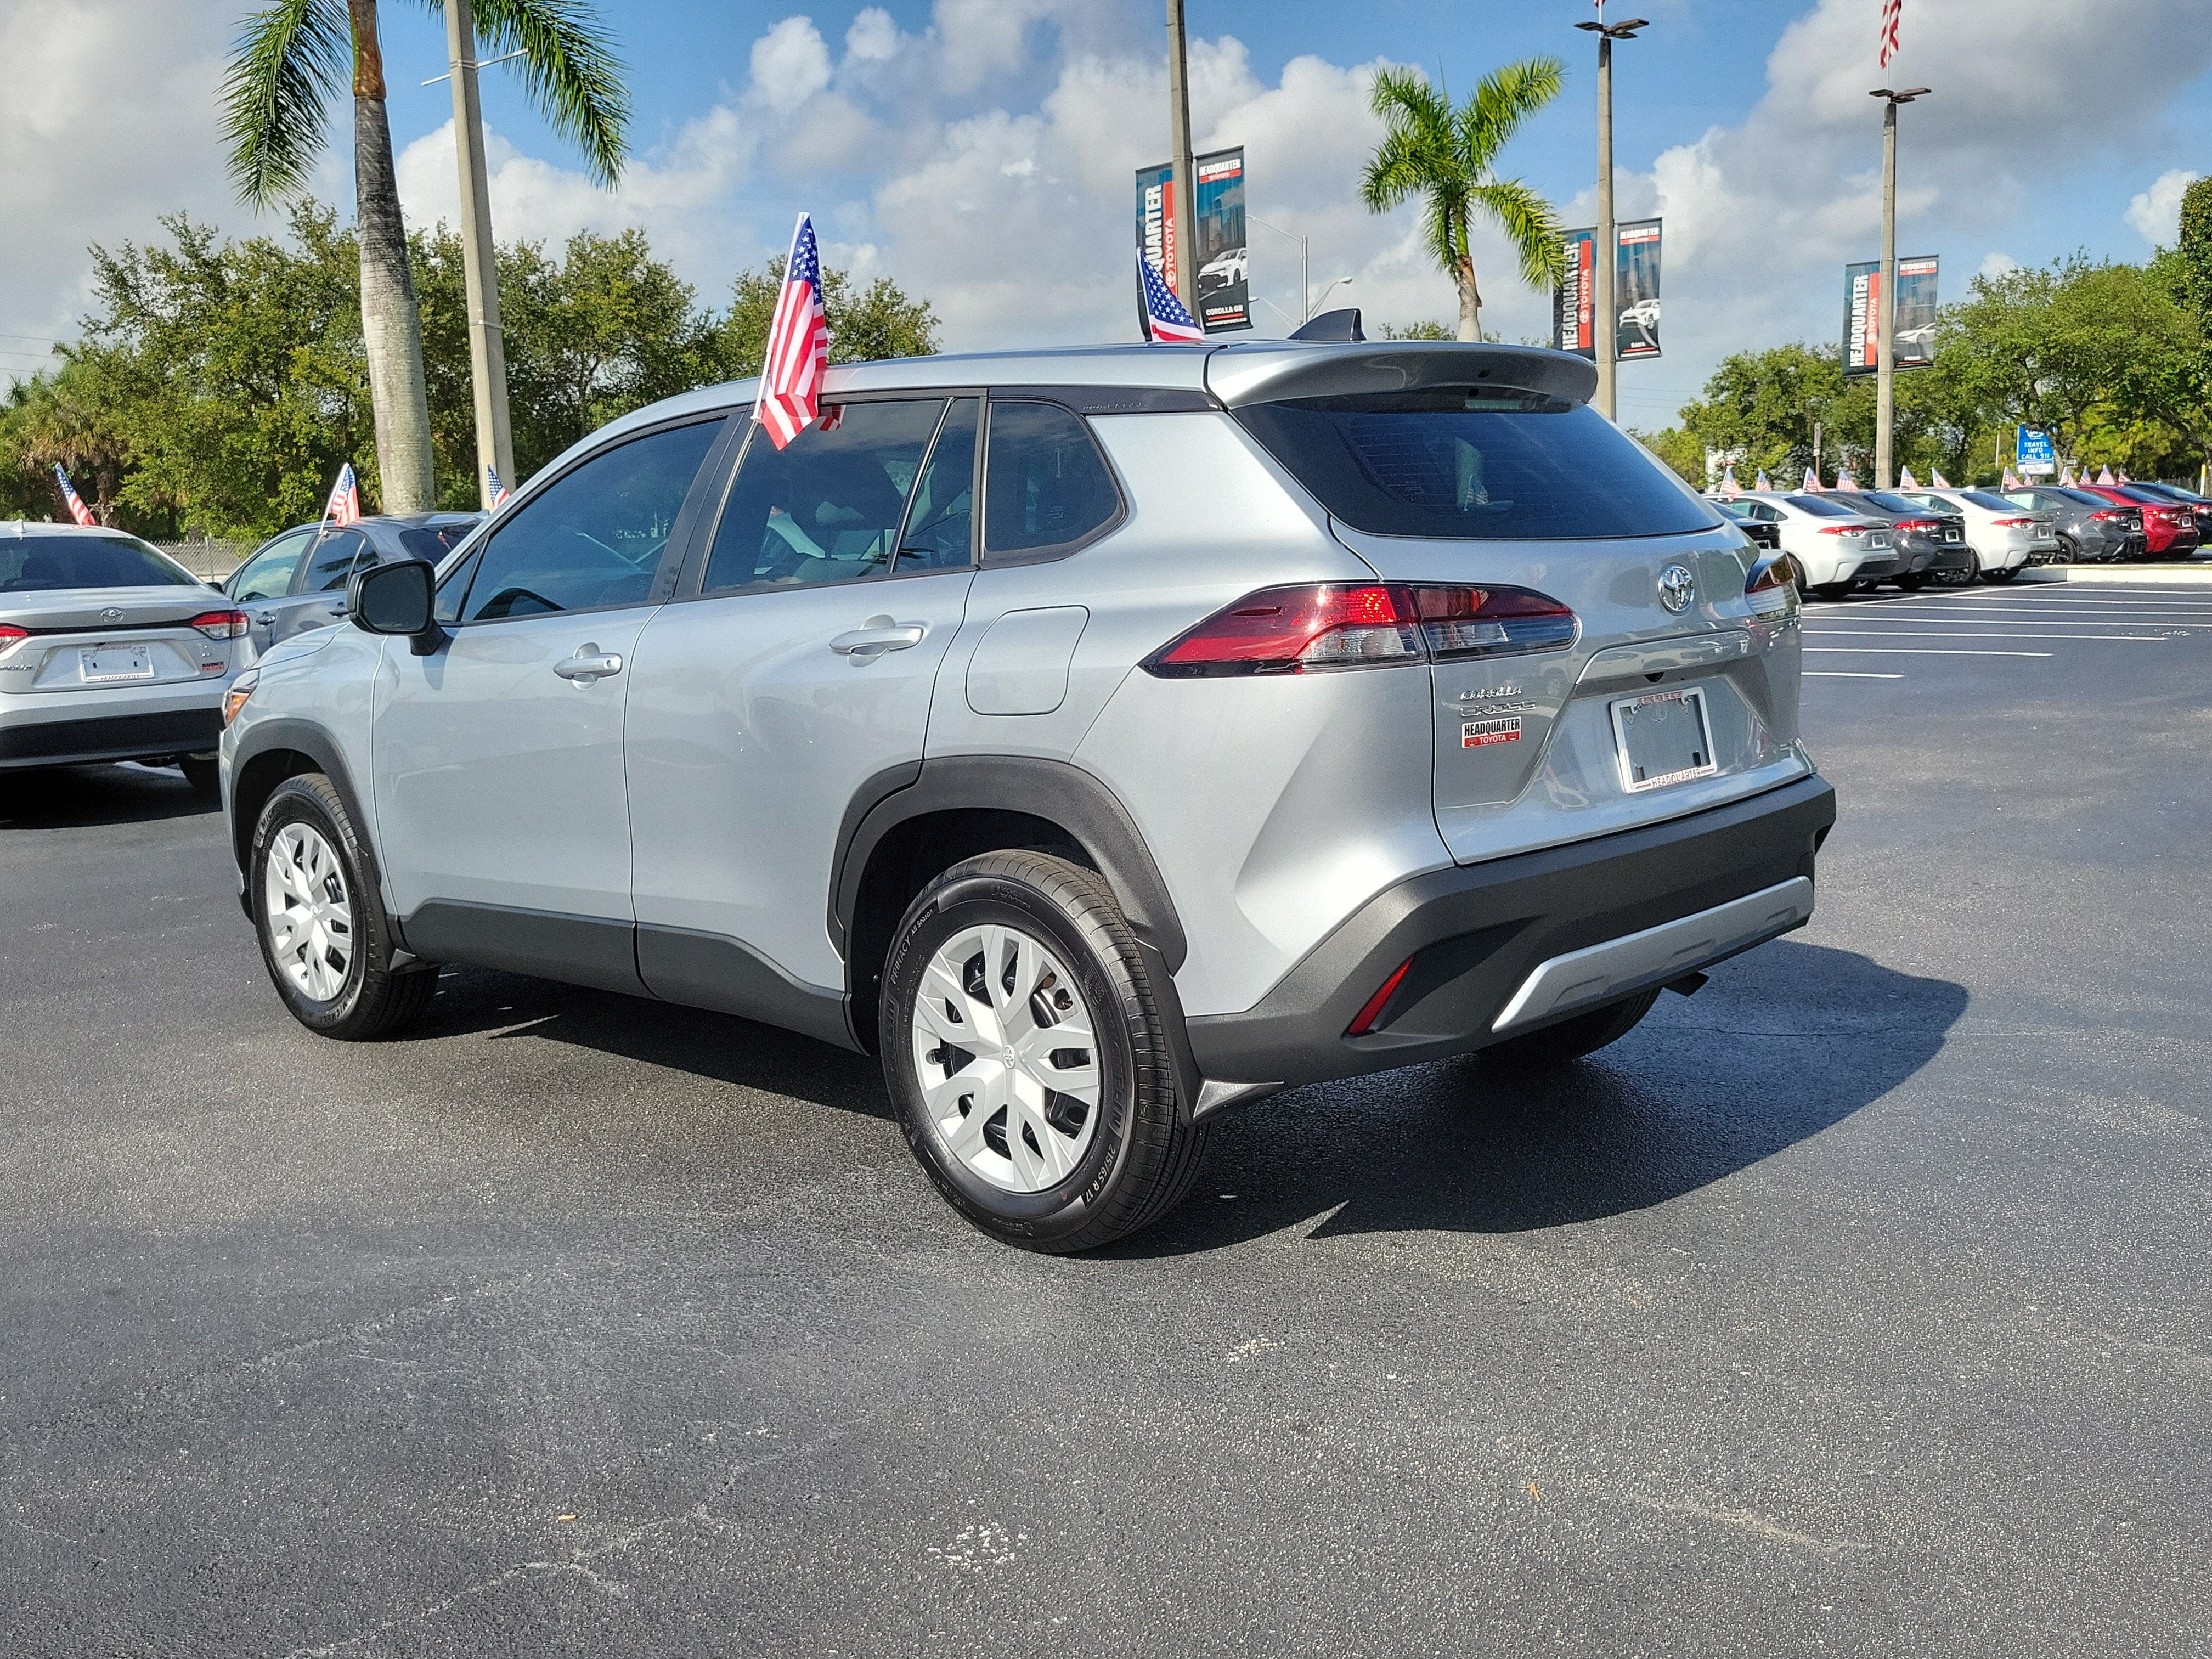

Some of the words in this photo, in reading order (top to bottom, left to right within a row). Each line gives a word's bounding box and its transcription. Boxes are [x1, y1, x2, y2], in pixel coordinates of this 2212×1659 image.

[1199, 159, 1242, 177] HEADQUARTER
[1145, 184, 1165, 278] QUARTER
[1166, 217, 1175, 271] TOYOTA
[1206, 306, 1233, 316] COROLLA
[1850, 274, 1869, 367] HEADQUARTER
[1464, 718, 1520, 737] HEADQUARTER
[1479, 734, 1506, 744] TOYOTA
[1651, 769, 1701, 788] HEADQUARTER
[890, 935, 911, 985] PRIMACY
[1098, 1143, 1116, 1183] 215/65
[1092, 1180, 1100, 1191] R
[1086, 1189, 1094, 1203] 17
